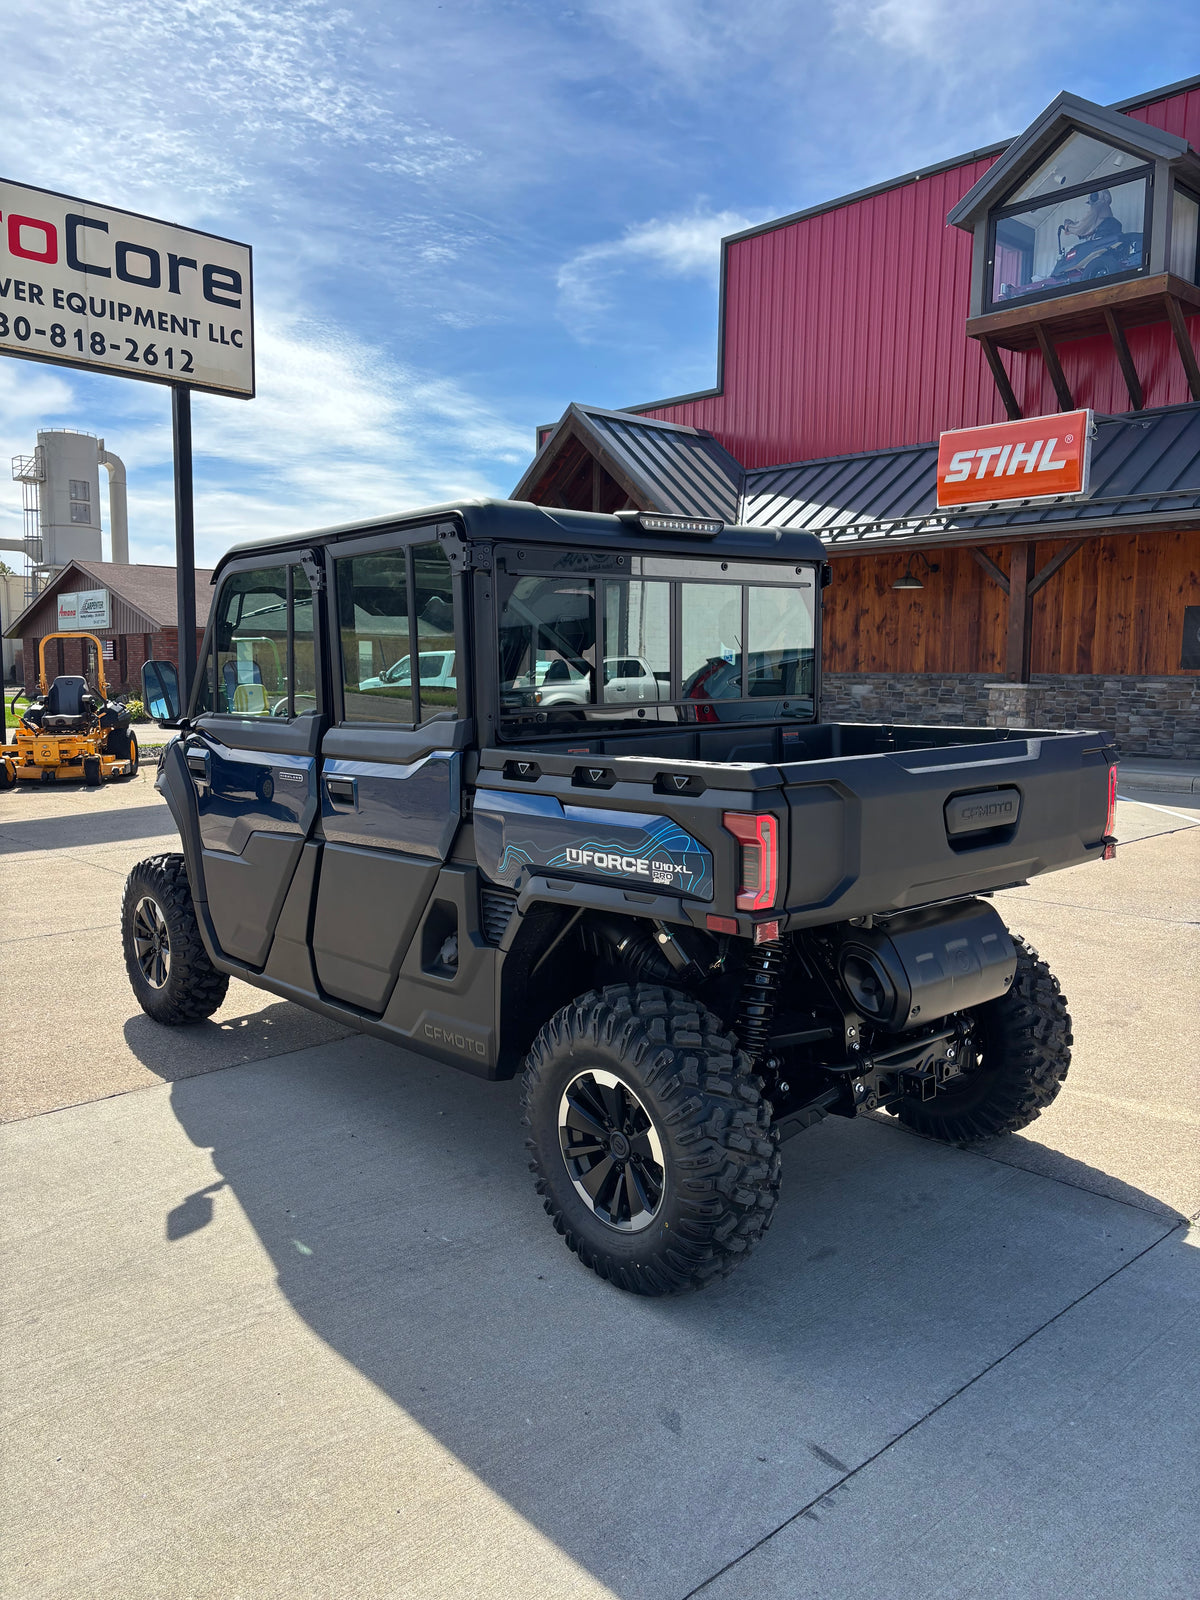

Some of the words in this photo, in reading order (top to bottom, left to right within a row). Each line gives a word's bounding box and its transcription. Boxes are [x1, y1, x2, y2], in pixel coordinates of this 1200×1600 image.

[0, 211, 242, 309] oCore
[53, 288, 200, 338] EQUIPMENT
[208, 323, 243, 349] LLC
[944, 438, 1067, 484] STIHL
[961, 801, 1013, 820] CFMOTO
[652, 870, 673, 881] PRO
[424, 1023, 486, 1056] CFMOTO
